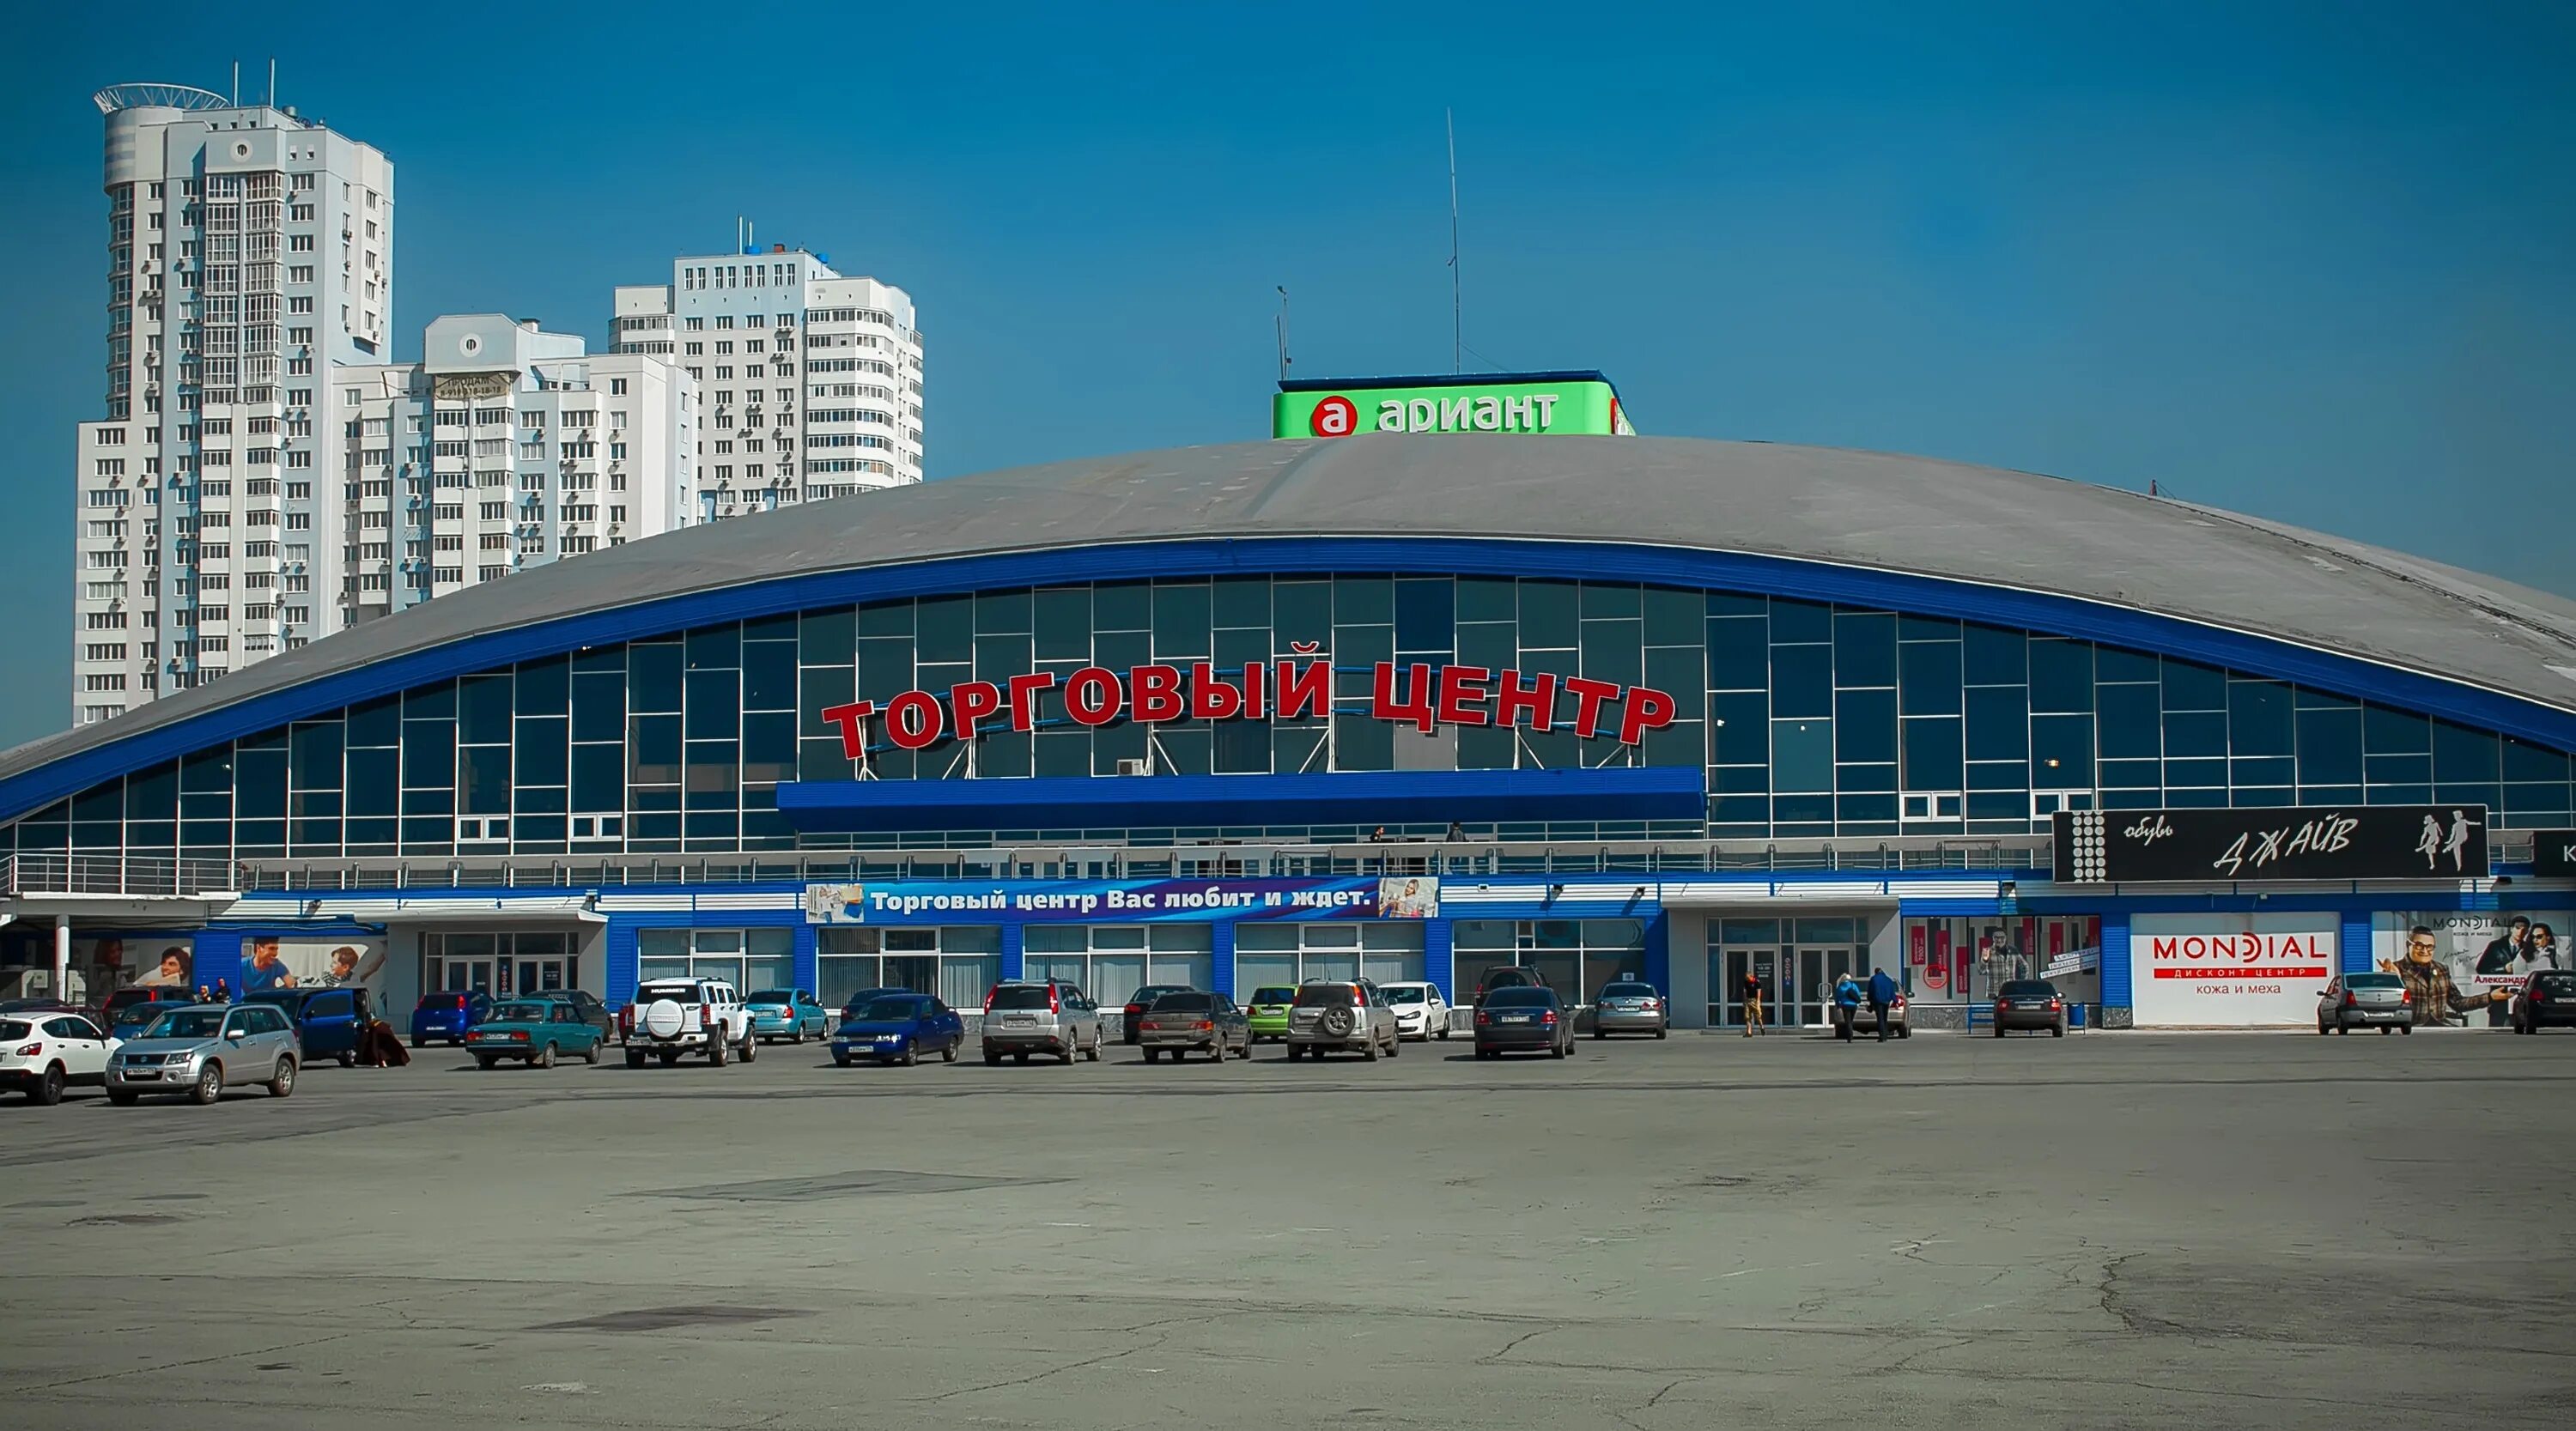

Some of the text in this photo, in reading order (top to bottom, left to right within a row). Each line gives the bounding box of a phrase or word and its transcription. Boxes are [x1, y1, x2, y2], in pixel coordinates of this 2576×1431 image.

[1379, 394, 1559, 433] ариант
[821, 640, 1676, 760] ТОРГОВЫЙ ЦЕНТР
[2123, 815, 2174, 846] обувь
[2213, 812, 2359, 876] ДЖАЙВ
[870, 886, 1371, 915] Торговый центр Вас любит и ждет.
[2433, 914, 2512, 931] MONDIAL
[2154, 931, 2328, 963] MONDIAL
[2174, 967, 2307, 979] ДИСКОНТ ЦЕНТР
[2196, 984, 2281, 995] кожа и меха
